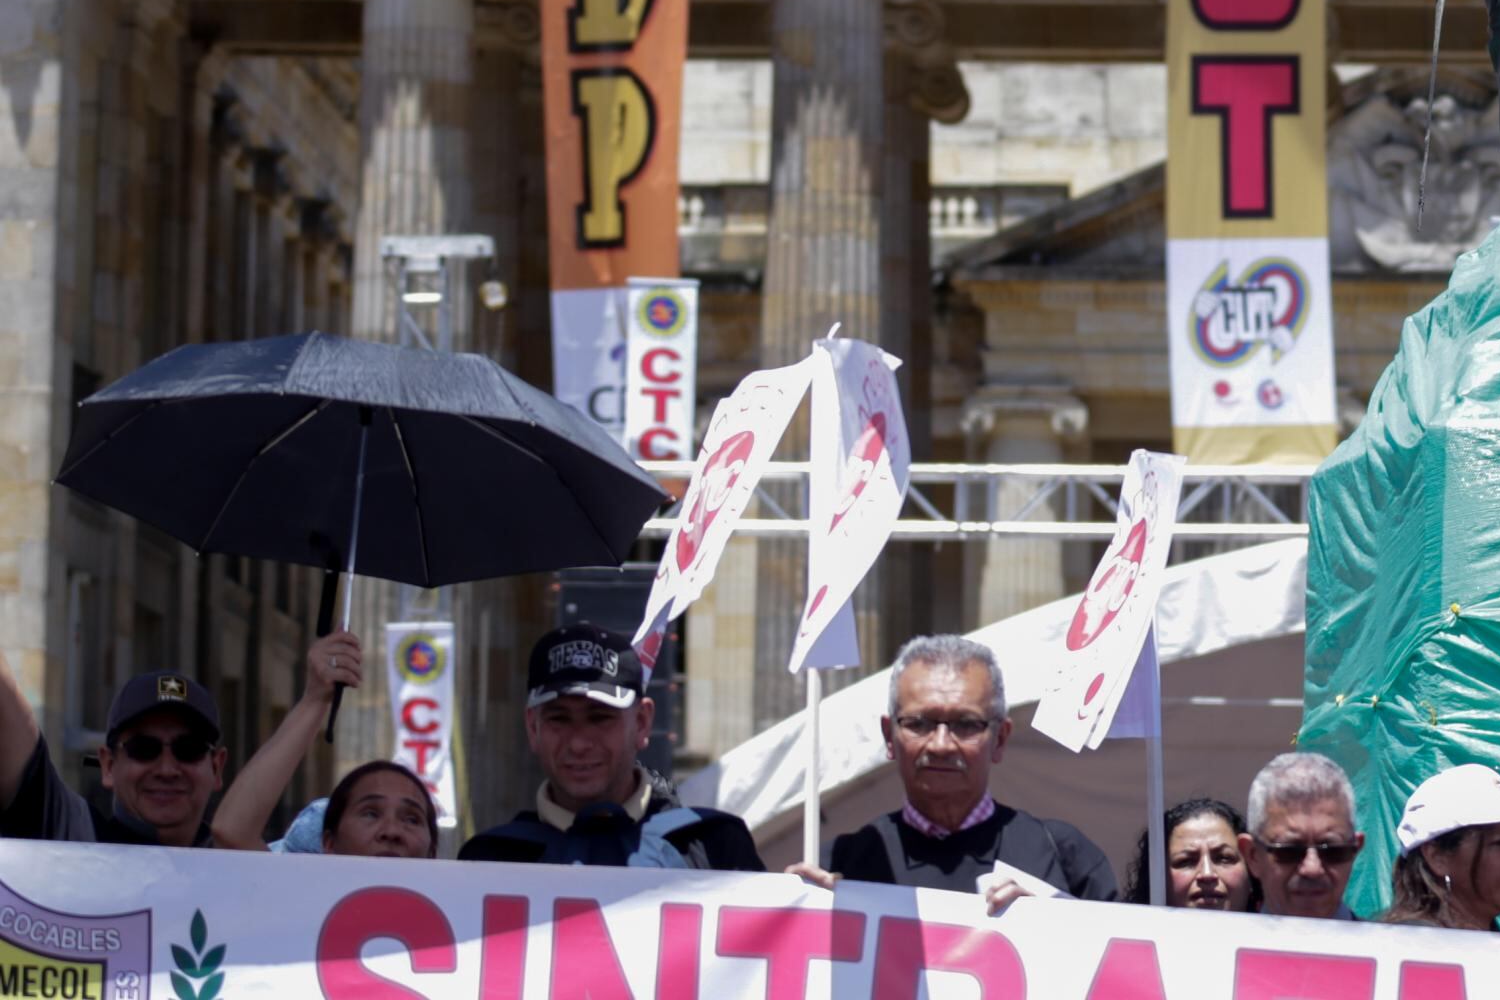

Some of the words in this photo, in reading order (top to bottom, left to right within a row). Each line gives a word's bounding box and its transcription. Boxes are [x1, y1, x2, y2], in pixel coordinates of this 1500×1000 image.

[587, 385, 627, 424] C
[638, 347, 682, 461] CTC
[548, 640, 619, 677] TEXAS
[401, 697, 442, 795] CT
[0, 906, 121, 951] COCABLES
